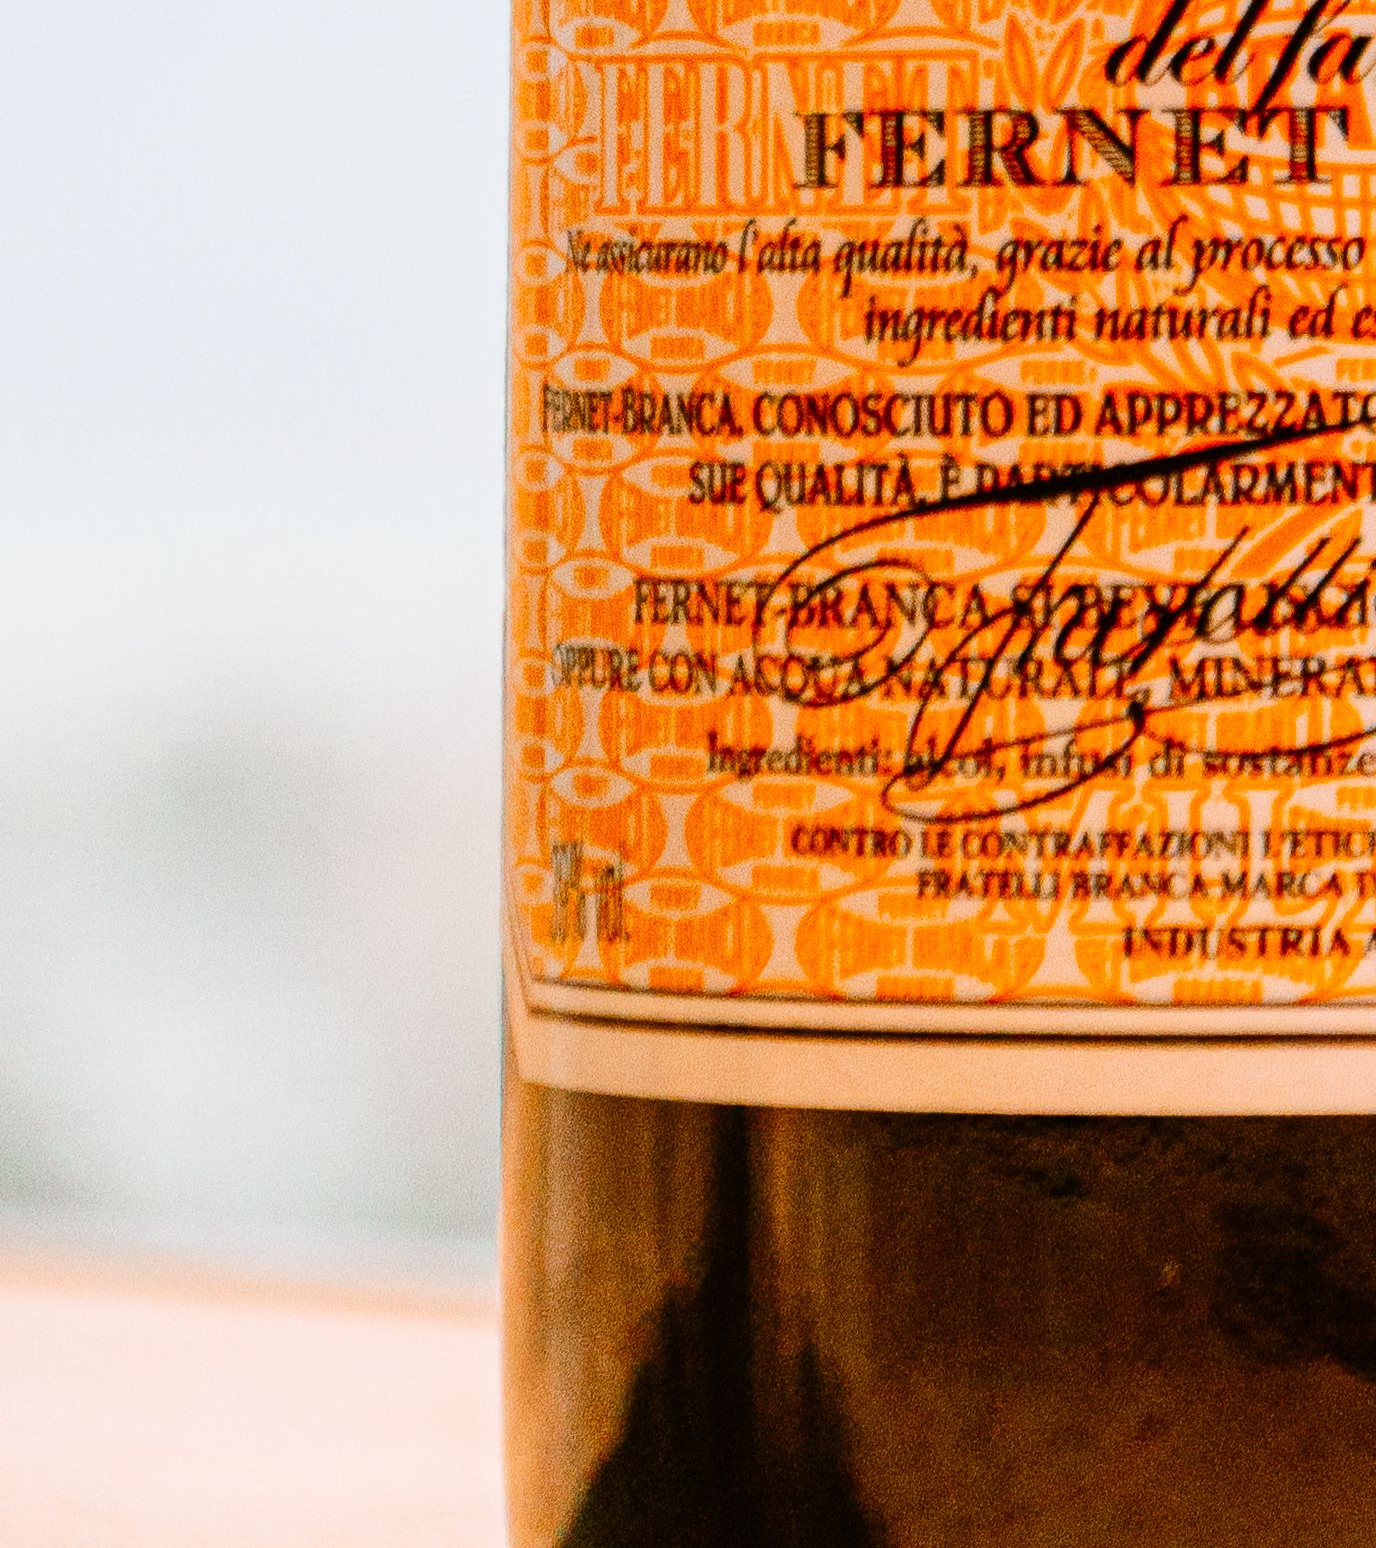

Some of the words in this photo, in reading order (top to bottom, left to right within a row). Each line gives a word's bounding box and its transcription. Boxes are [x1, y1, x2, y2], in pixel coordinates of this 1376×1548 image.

[792, 104, 1350, 191] FERNET
[738, 217, 822, 276] l'alta
[832, 216, 980, 298] qualità,
[995, 221, 1122, 294] grazie
[1134, 212, 1190, 273] al
[1172, 230, 1366, 297] processo
[864, 285, 1078, 367] ingredienti
[1093, 283, 1272, 341] naturali
[1286, 283, 1349, 340] ed
[752, 389, 1014, 440] CONOSCIUTO
[1026, 391, 1083, 438] ED
[647, 648, 718, 694] CON
[705, 729, 892, 784] Ingredienti:
[1147, 736, 1187, 779] di
[790, 823, 912, 860] CONTRO
[919, 826, 952, 860] LE
[959, 826, 1250, 860] CONTRAFFAZIONI
[916, 867, 1061, 902] FRATELLI
[1070, 867, 1208, 901] BRANCA
[1219, 867, 1344, 900] MARCA
[1122, 923, 1351, 960] INDUSTRIA
